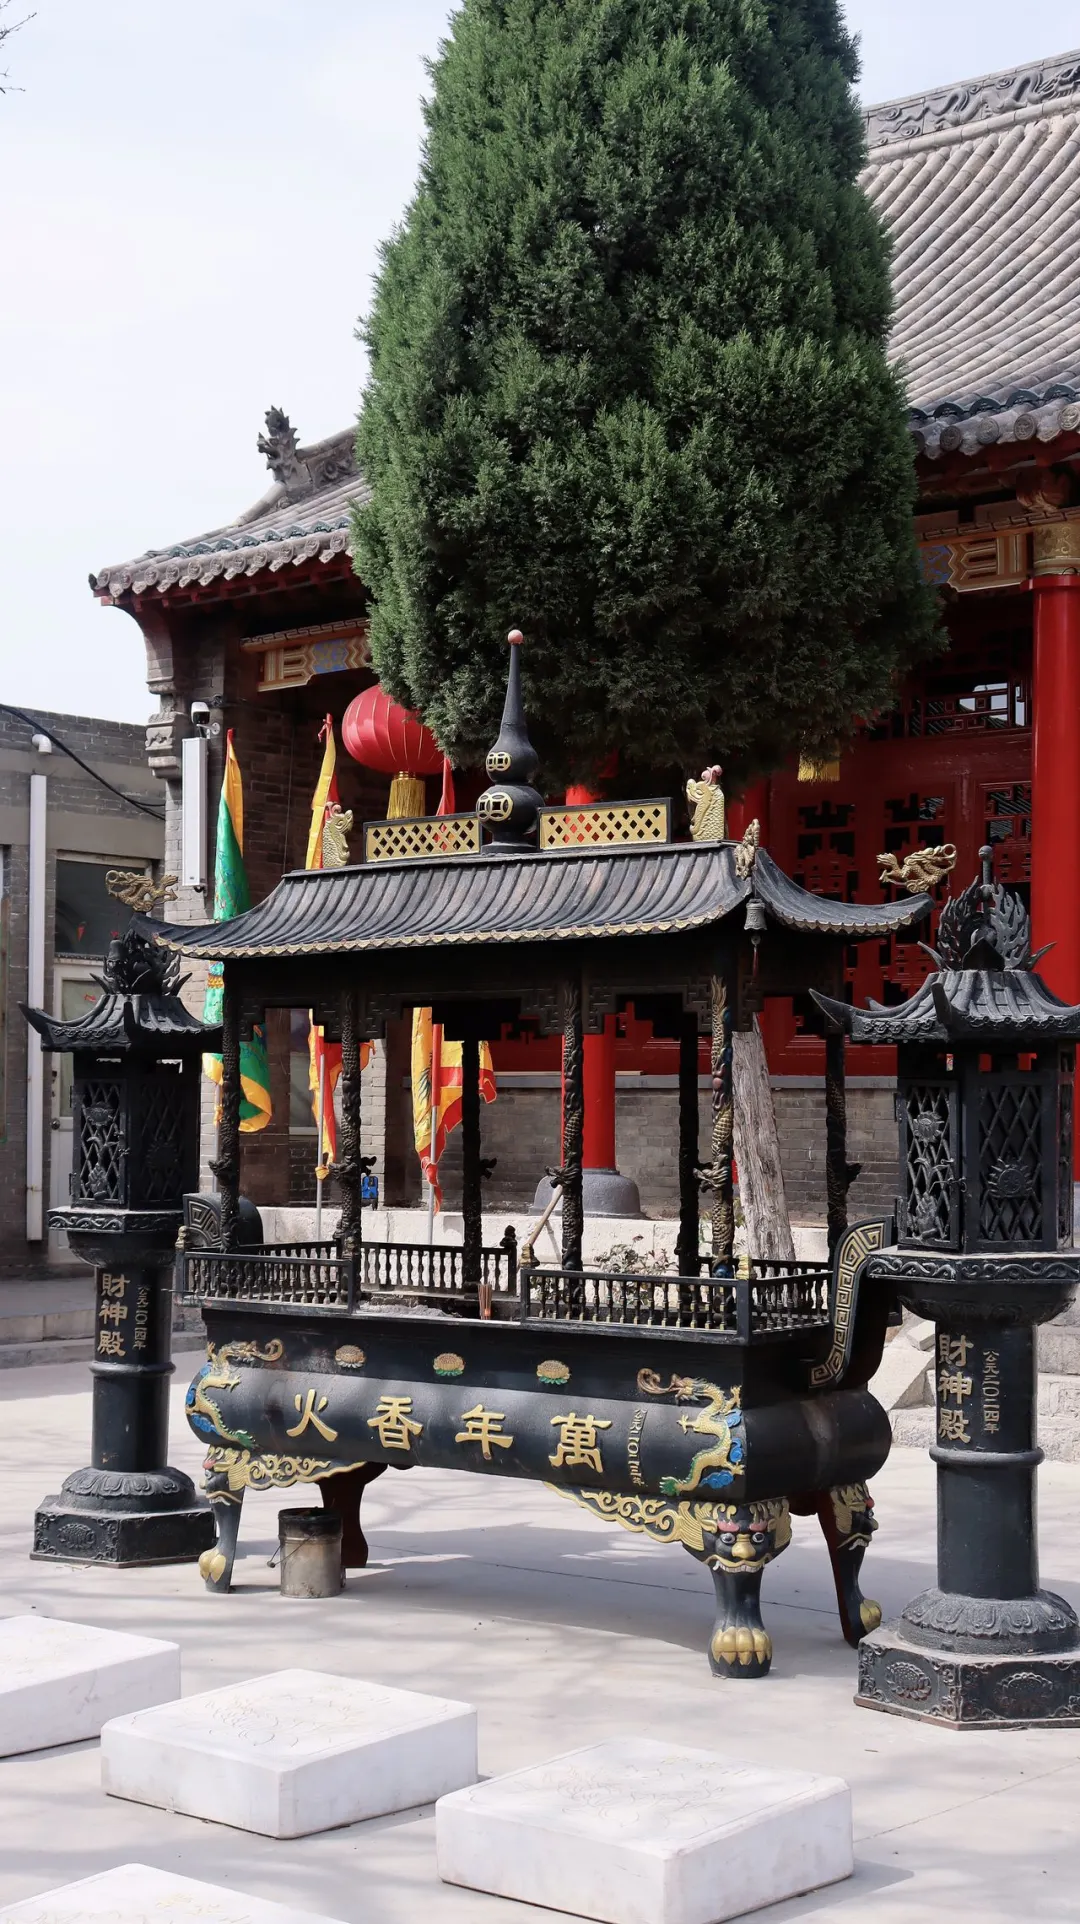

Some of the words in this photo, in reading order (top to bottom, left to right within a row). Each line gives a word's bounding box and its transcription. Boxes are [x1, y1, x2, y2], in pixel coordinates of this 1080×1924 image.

[98, 1273, 131, 1357] 財神殿
[937, 1333, 974, 1444] 財神殿
